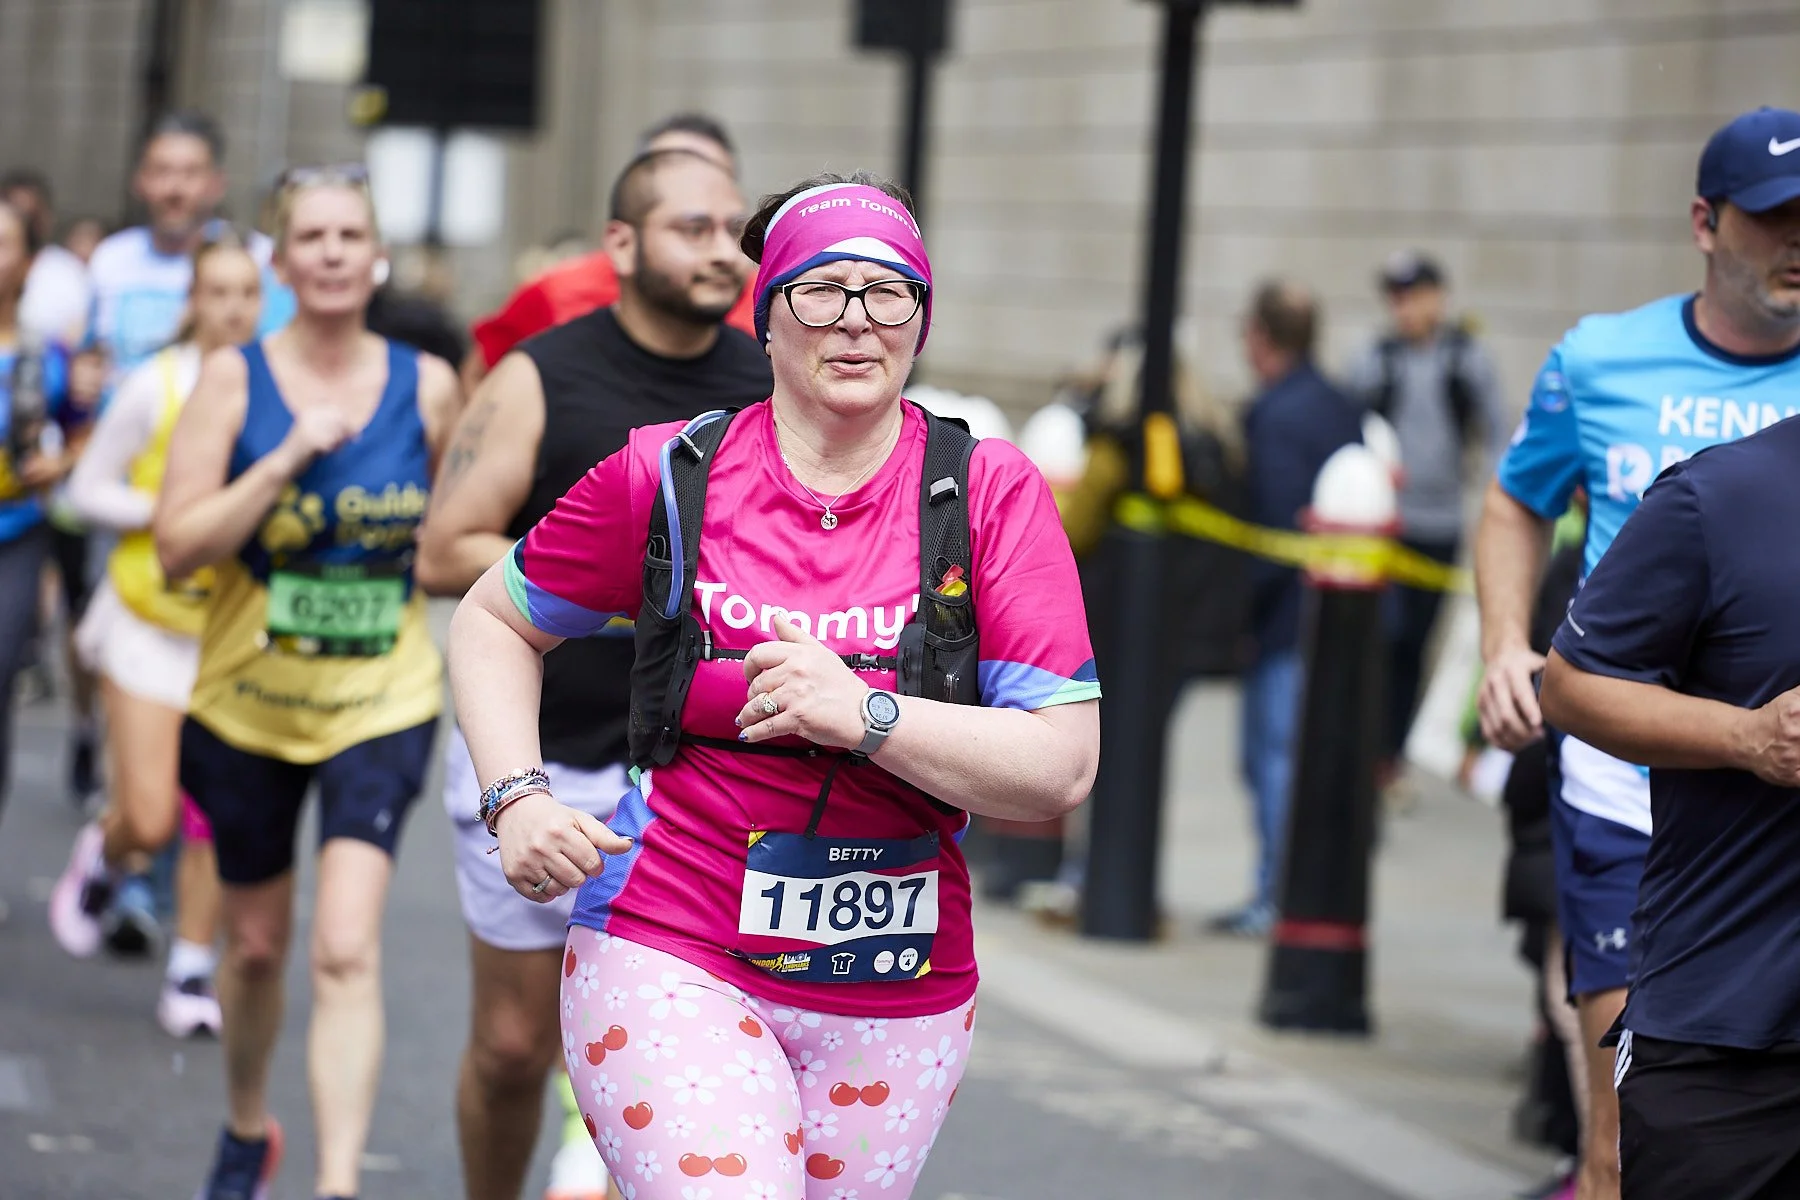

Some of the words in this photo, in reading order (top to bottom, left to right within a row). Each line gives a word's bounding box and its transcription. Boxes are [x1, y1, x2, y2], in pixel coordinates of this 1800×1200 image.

[798, 198, 851, 218] Team
[1658, 395, 1800, 439] KENN
[828, 847, 884, 862] BETTY
[760, 877, 927, 932] 11897
[749, 958, 777, 968] ONDON
[904, 958, 911, 967] 4
